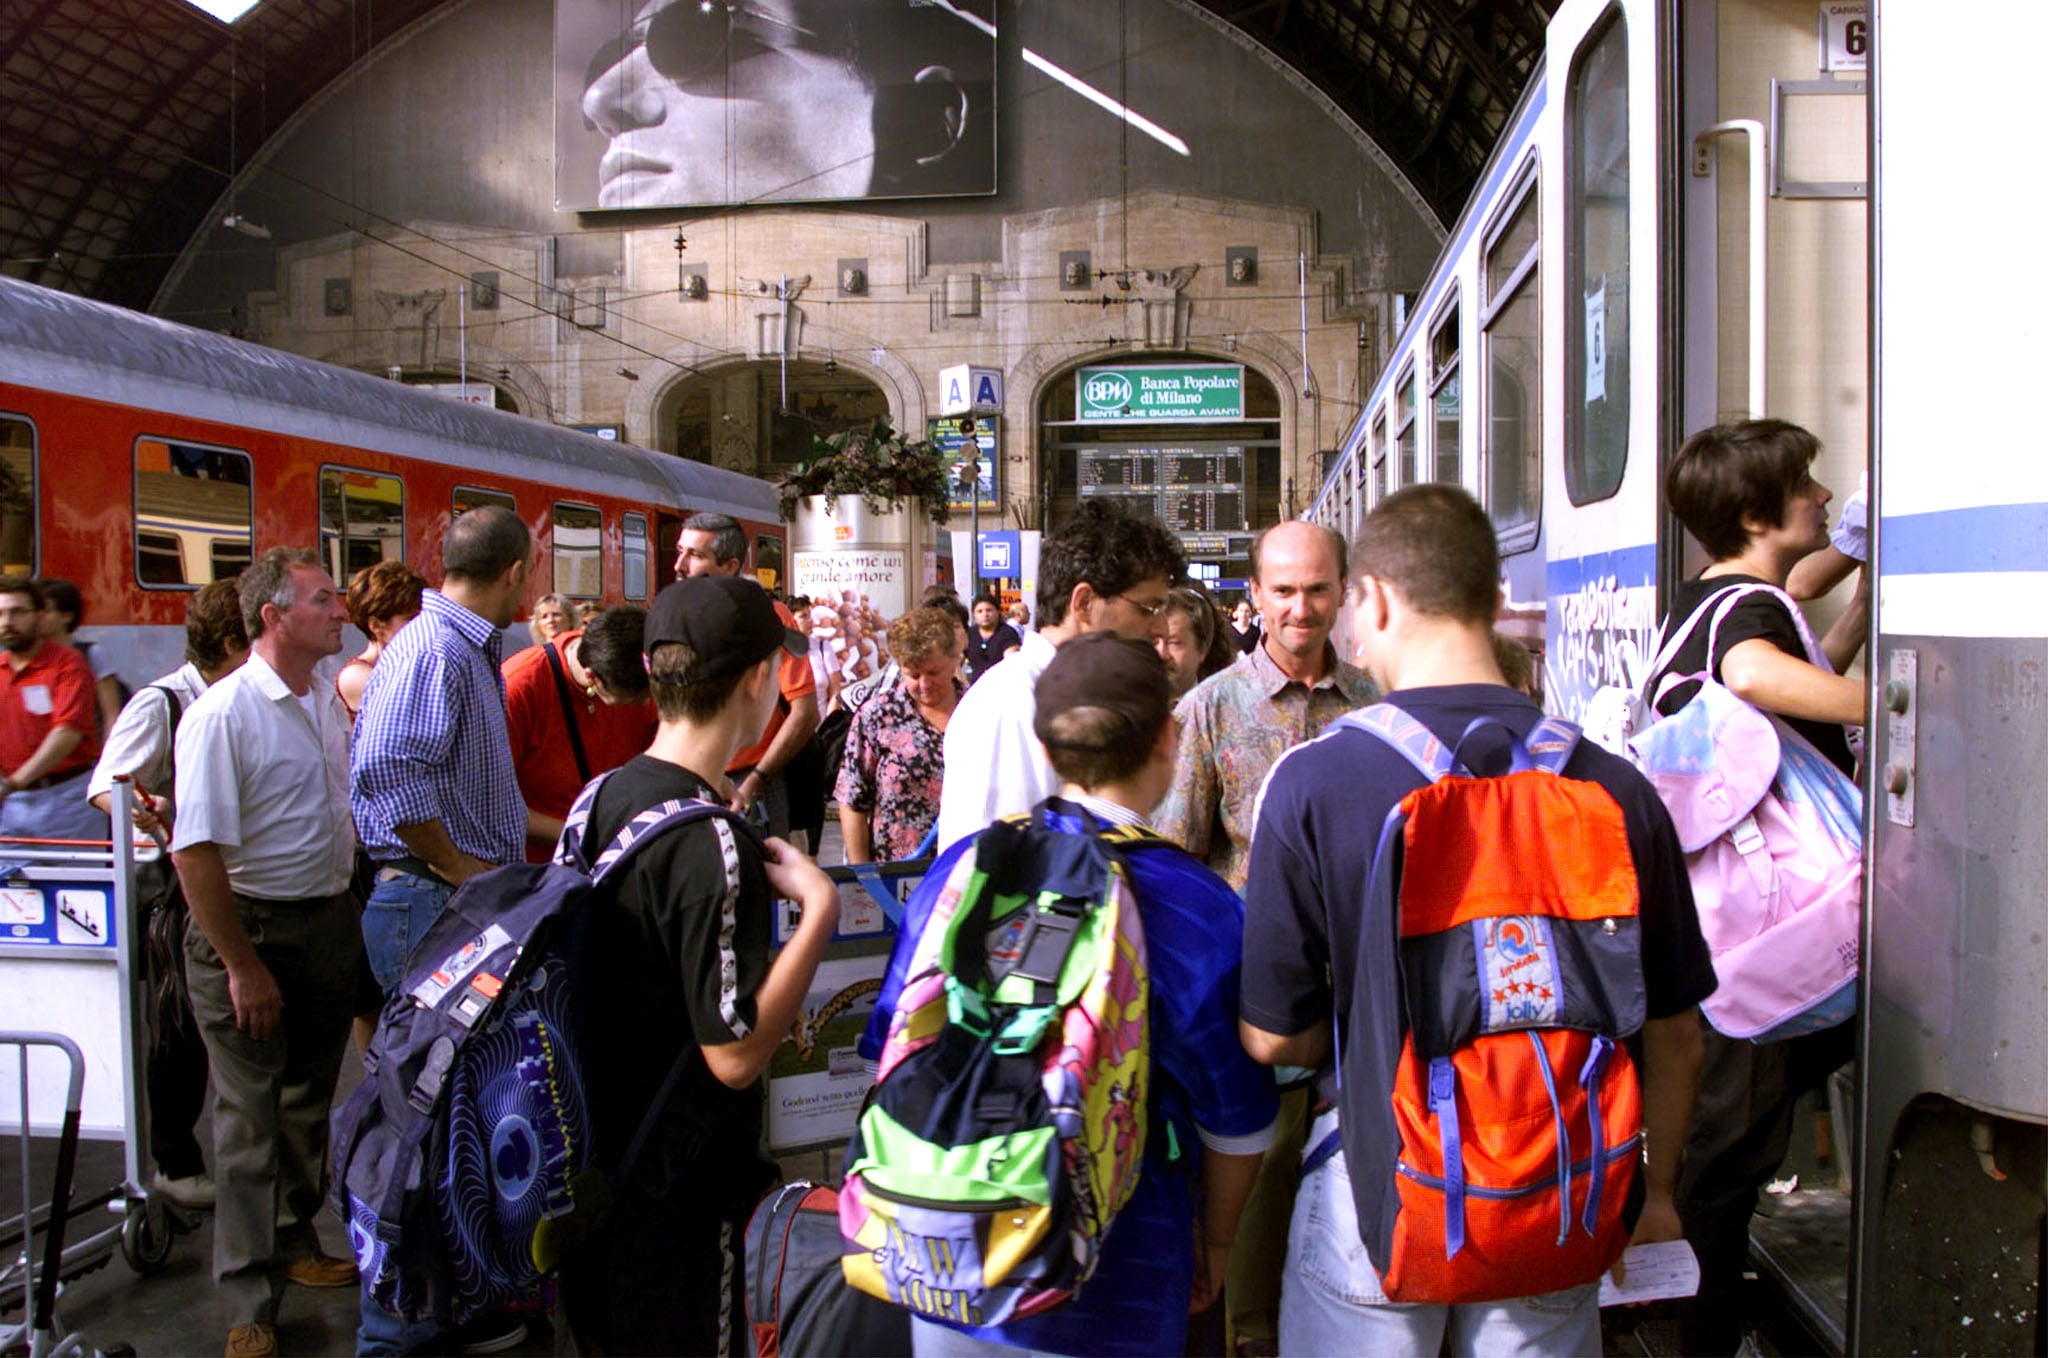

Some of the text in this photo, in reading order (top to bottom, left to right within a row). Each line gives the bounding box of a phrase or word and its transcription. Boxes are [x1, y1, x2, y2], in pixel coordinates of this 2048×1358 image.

[1845, 20, 1866, 56] 6
[948, 378, 963, 406] A
[976, 376, 997, 404] A
[1088, 381, 1129, 401] BPM
[1140, 375, 1239, 392] Banca Popolare
[1140, 391, 1202, 405] di Milano
[1084, 410, 1121, 418] GENTE
[1150, 408, 1196, 417] GUARDA
[1199, 407, 1240, 416] AVANTI
[838, 556, 879, 568] come
[884, 556, 903, 568] un
[845, 571, 893, 583] amore
[1506, 1001, 1545, 1024] jolly
